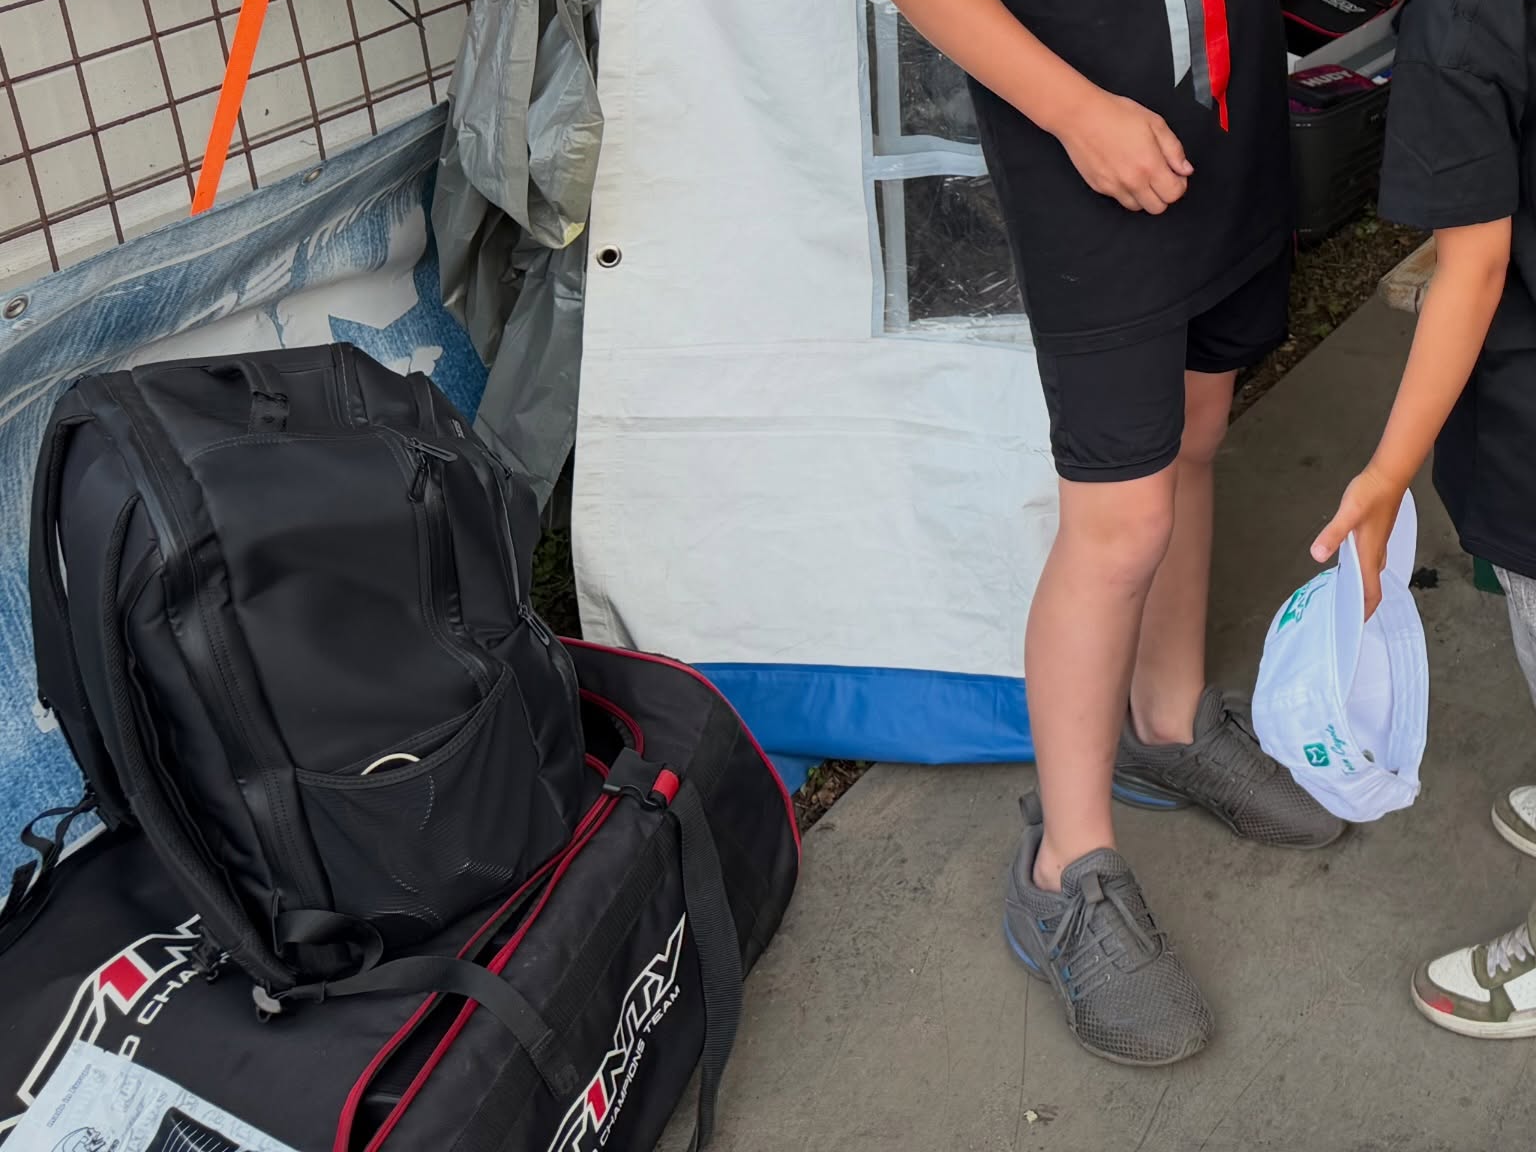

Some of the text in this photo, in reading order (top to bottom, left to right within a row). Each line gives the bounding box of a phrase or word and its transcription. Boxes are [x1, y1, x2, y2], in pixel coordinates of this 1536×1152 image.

[1302, 70, 1352, 88] HUDY
[599, 984, 681, 1148] CHAMPIONS TEAM
